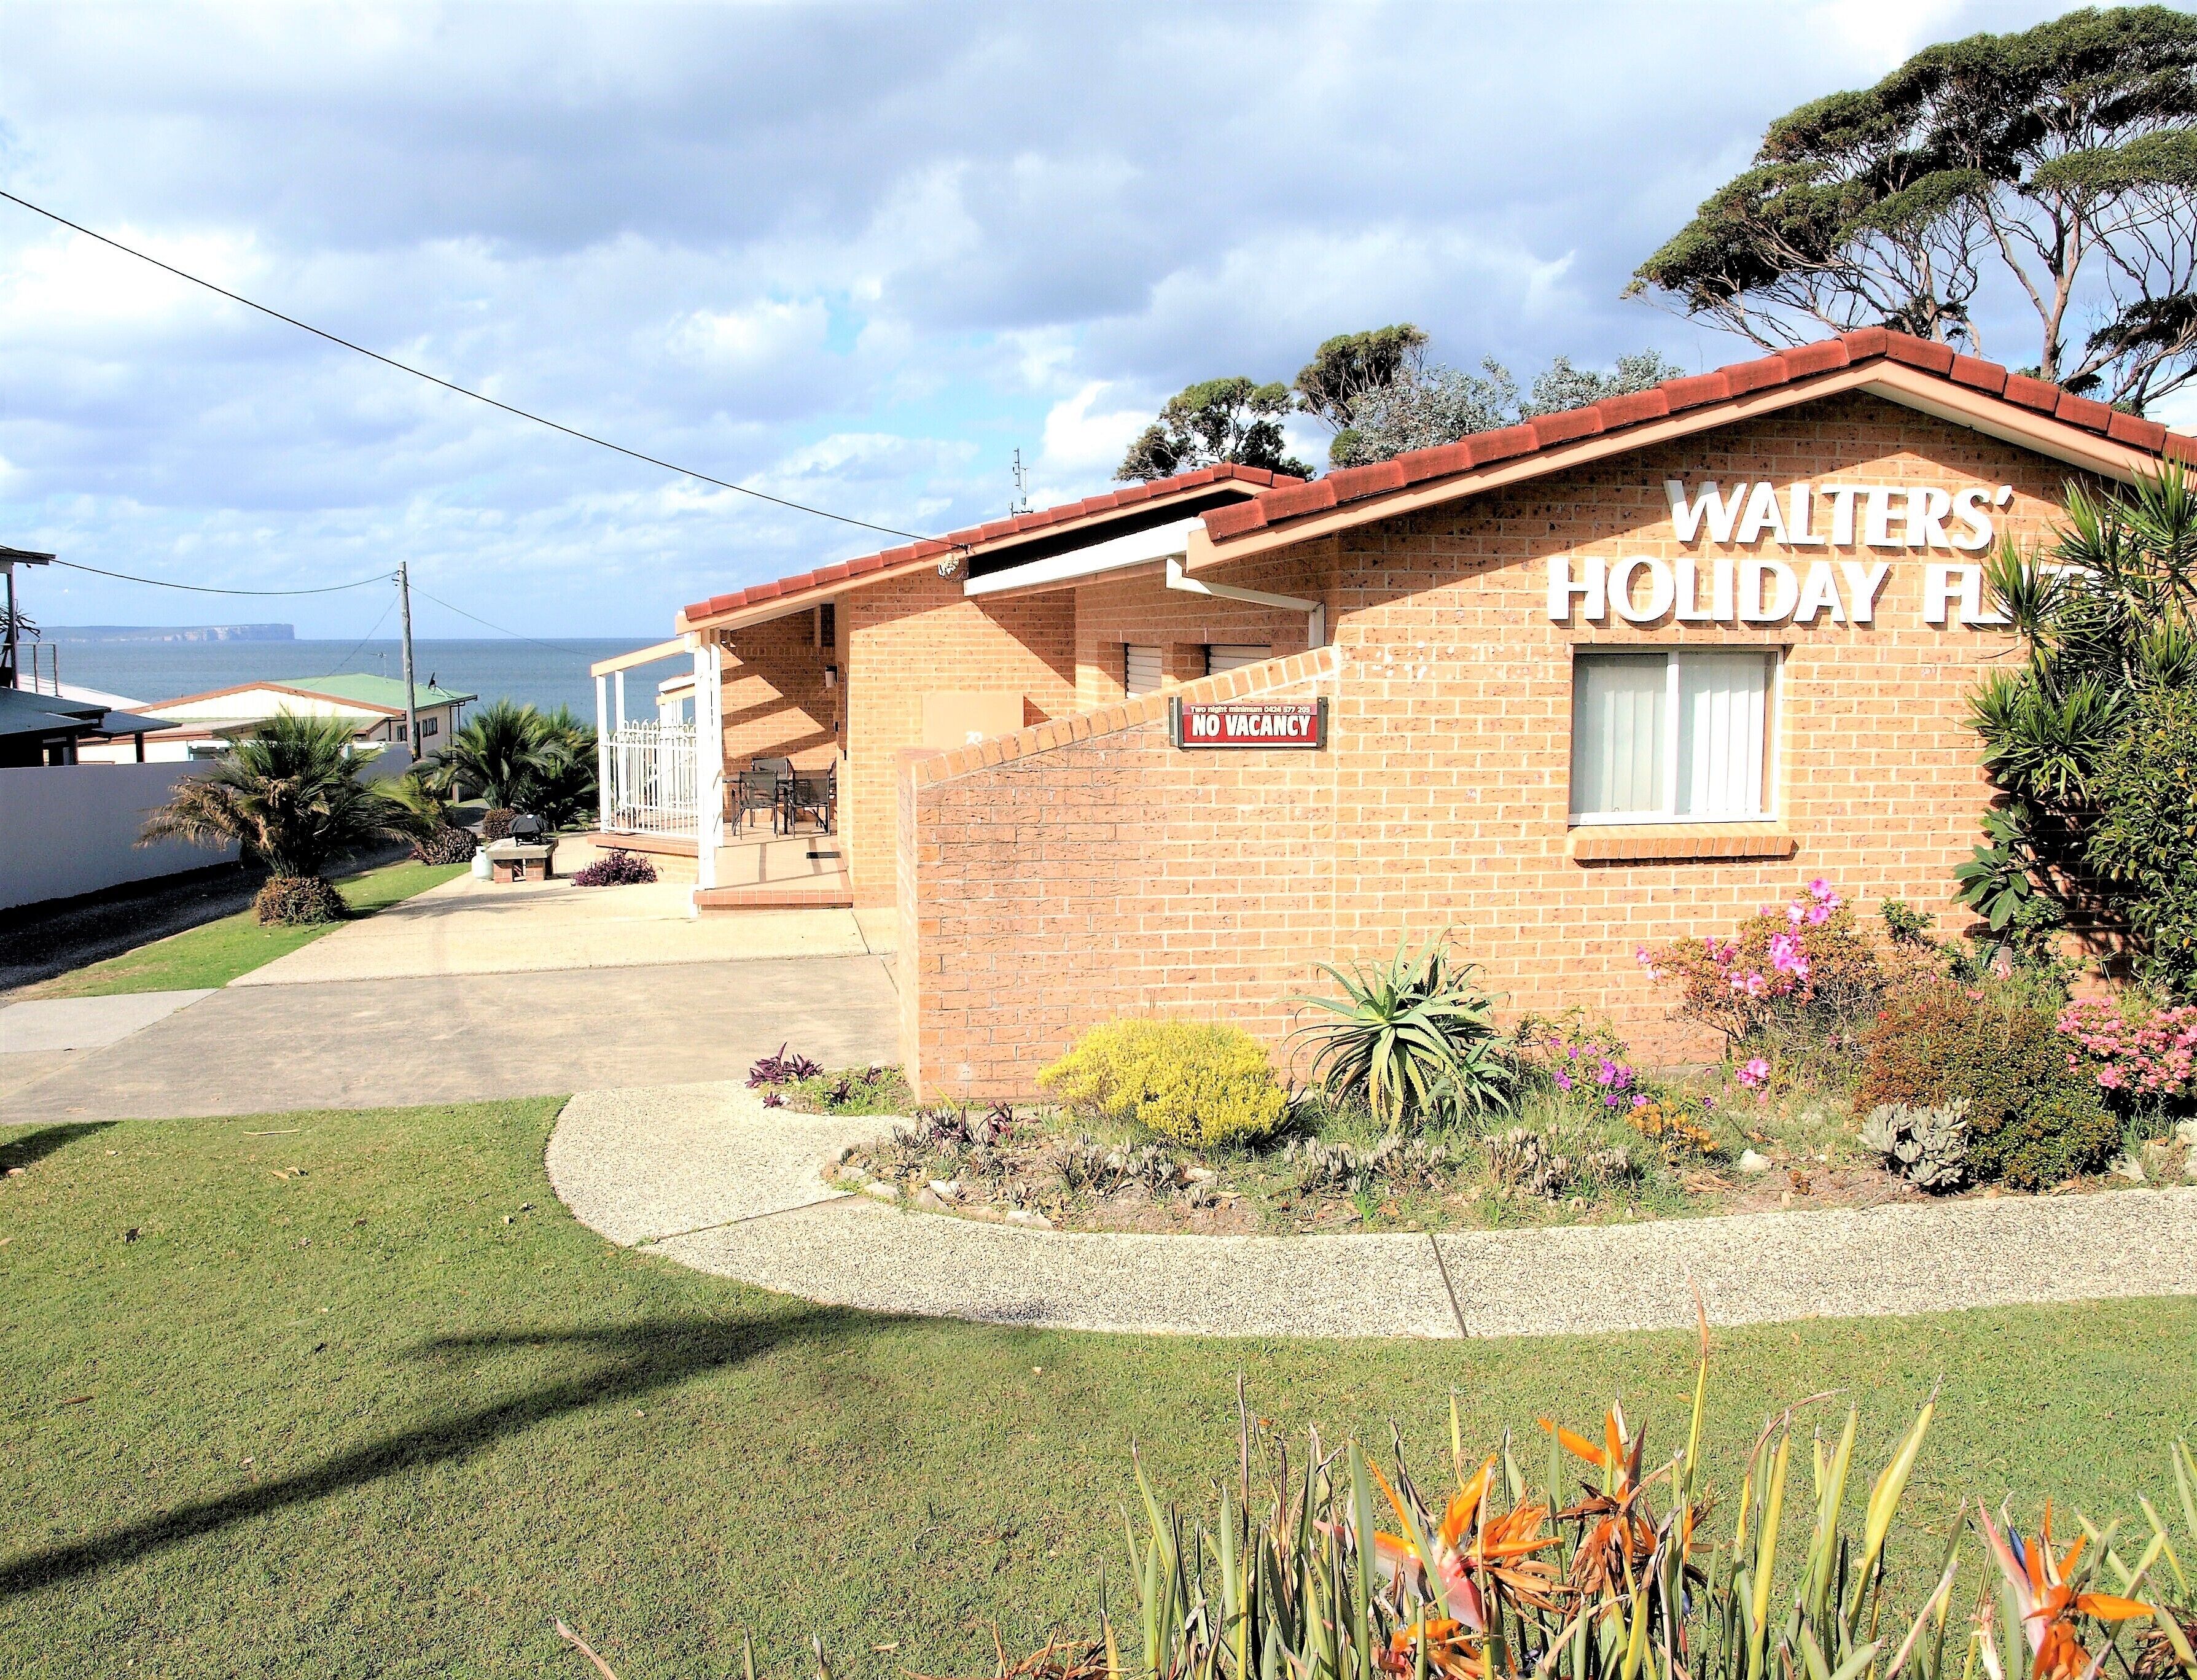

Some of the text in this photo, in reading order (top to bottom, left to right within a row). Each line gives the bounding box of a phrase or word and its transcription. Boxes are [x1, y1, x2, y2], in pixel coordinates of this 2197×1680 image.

[1663, 479, 2013, 550] WALTERS'
[1547, 556, 1891, 623] HOLIDAY
[1192, 715, 1311, 737] NO VACANCY
